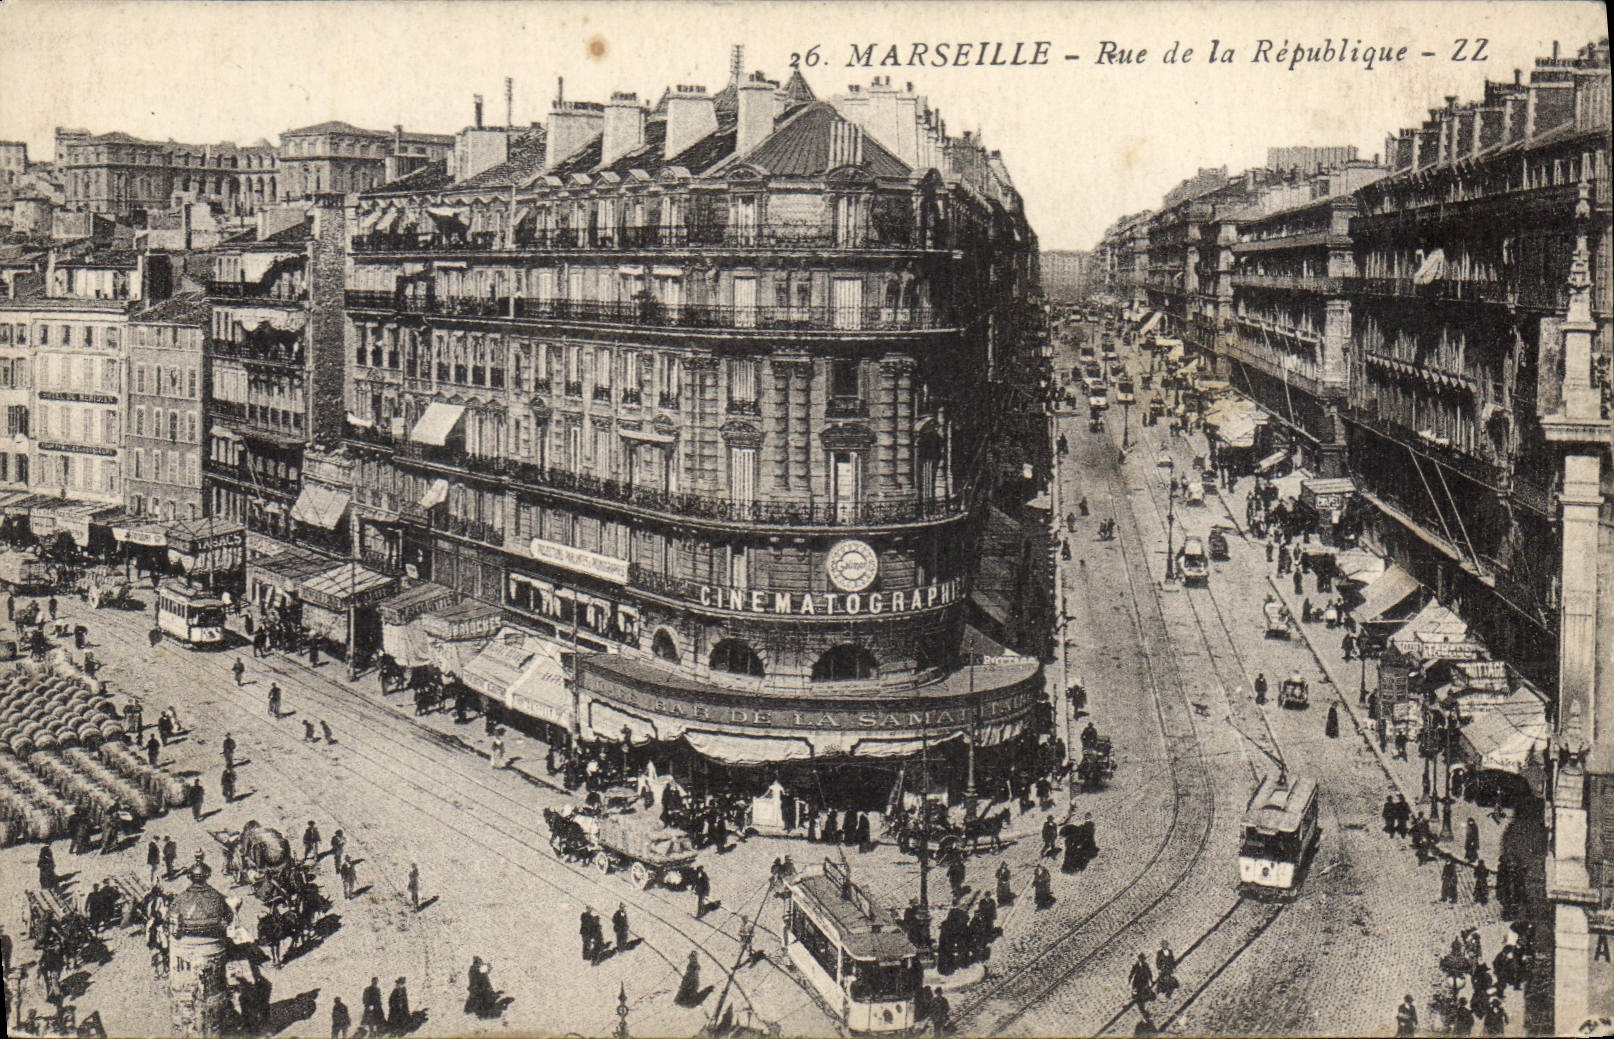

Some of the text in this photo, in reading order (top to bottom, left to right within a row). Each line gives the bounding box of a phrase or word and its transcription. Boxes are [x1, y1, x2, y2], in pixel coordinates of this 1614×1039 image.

[654, 699, 710, 720] BAR
[730, 711, 772, 725] DE
[793, 713, 841, 727] LA
